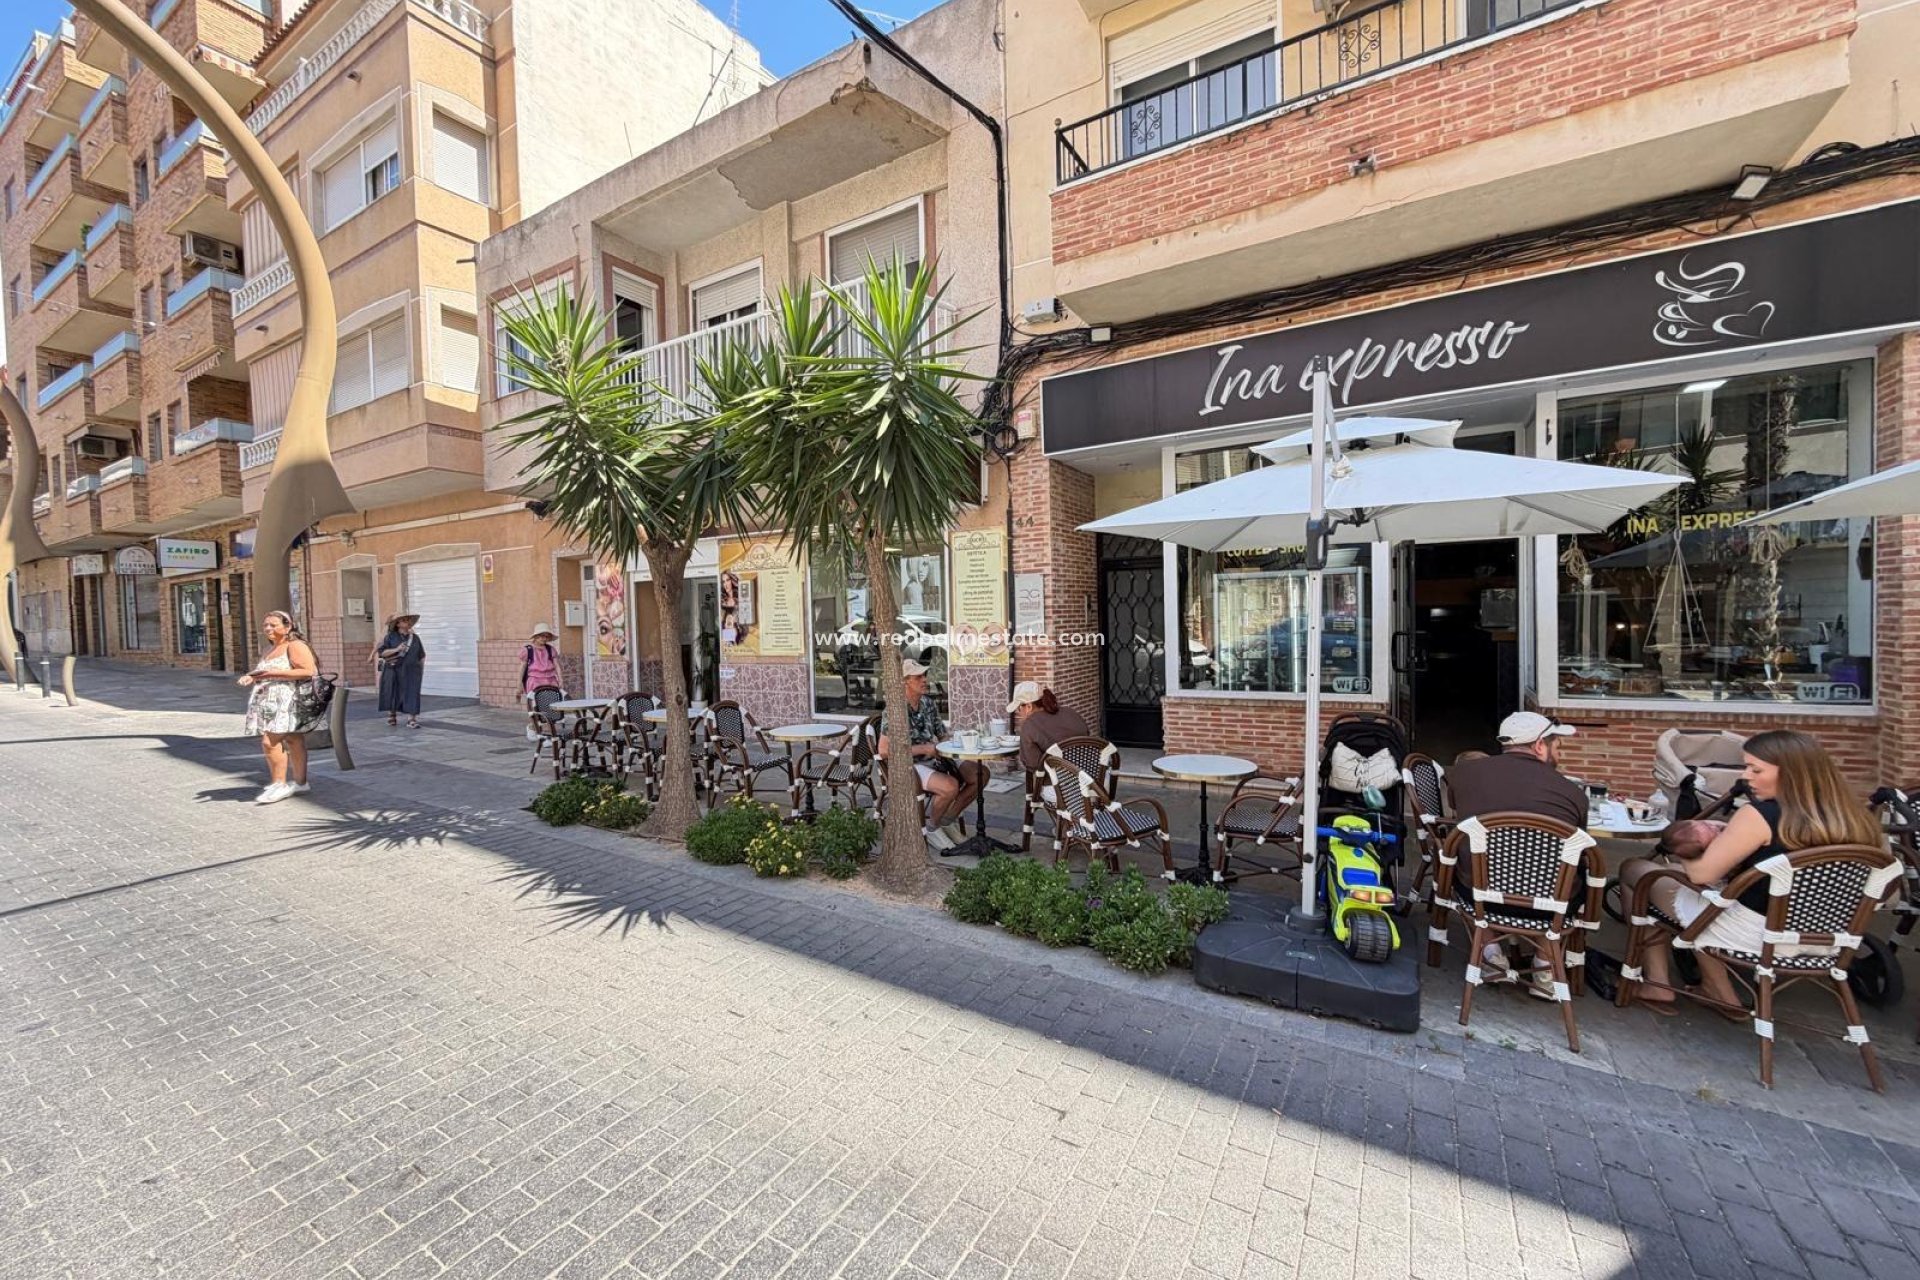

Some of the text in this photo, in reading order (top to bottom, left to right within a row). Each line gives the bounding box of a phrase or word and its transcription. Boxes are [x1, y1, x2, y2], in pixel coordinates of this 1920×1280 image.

[1198, 321, 1530, 416] Ina expresso
[1015, 516, 1035, 528] 44
[1627, 516, 1659, 534] INA
[166, 547, 210, 555] ZAFIRO
[1278, 544, 1308, 554] SHO
